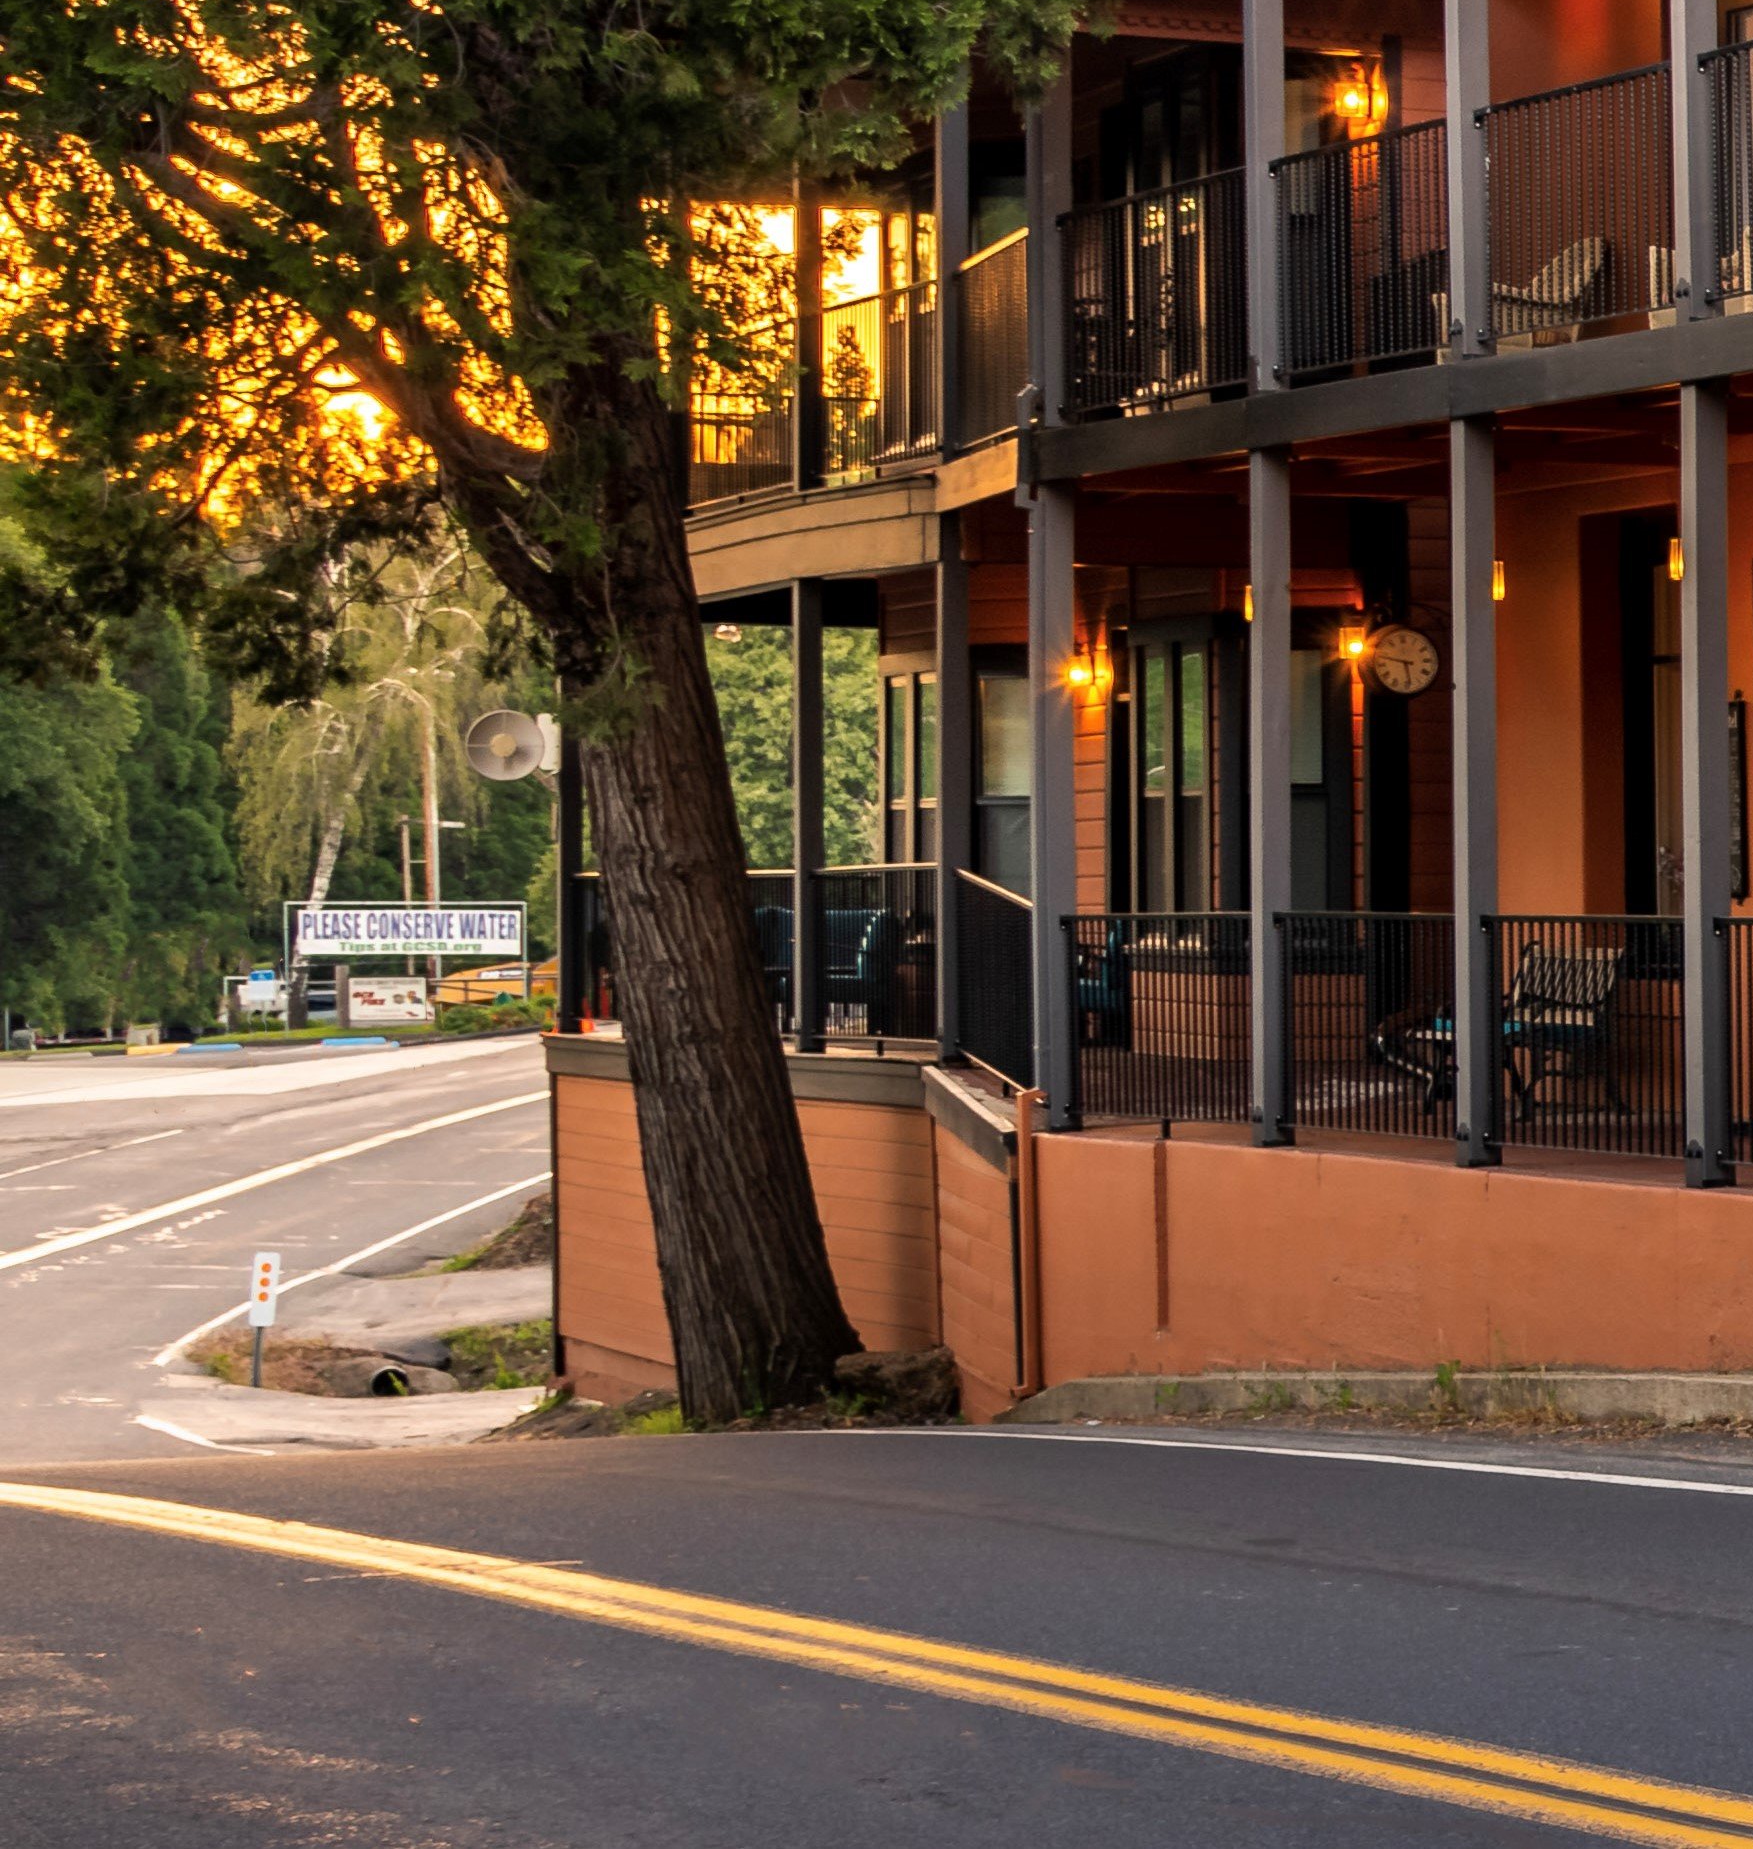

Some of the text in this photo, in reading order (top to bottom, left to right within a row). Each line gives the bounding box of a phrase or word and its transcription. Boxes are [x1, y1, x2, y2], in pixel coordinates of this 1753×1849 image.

[302, 913, 517, 940] PLEASE CONSERVE WATER
[339, 942, 376, 953] Tips
[381, 942, 398, 952] at
